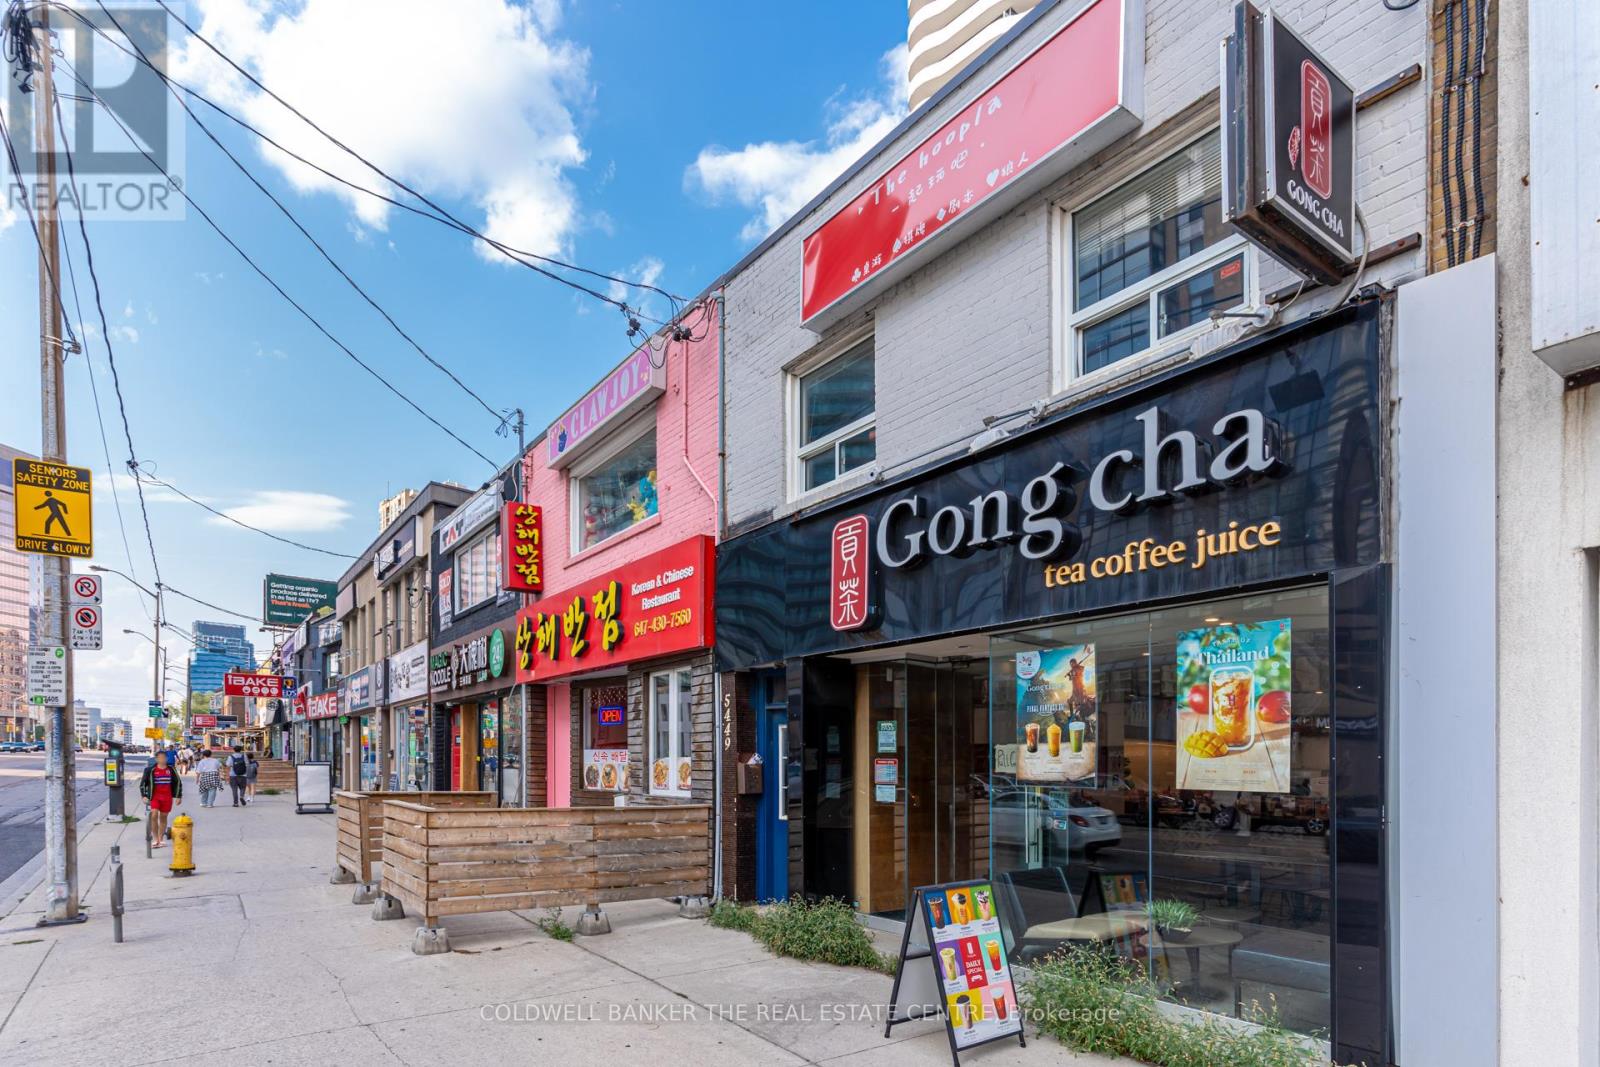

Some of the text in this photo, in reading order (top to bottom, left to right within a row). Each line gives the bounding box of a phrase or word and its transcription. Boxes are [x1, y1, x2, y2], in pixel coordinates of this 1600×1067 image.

[870, 96, 1002, 205] The hoopla
[1286, 179, 1344, 238] GONG CHA
[16, 472, 89, 491] SAFETY ZONE
[876, 406, 1275, 568] Gong cha
[17, 538, 91, 555] DRIVE SLOWLY
[1044, 521, 1281, 588] tea coffee juice
[631, 566, 694, 596] Korean & Chinese
[642, 587, 680, 611] Restaurant
[633, 608, 692, 637] 647-430-7560
[602, 710, 621, 723] OPEN
[723, 694, 731, 751] 5449
[592, 751, 609, 763] 신속
[965, 959, 981, 969] DAILY
[967, 967, 983, 975] SPECIAL
